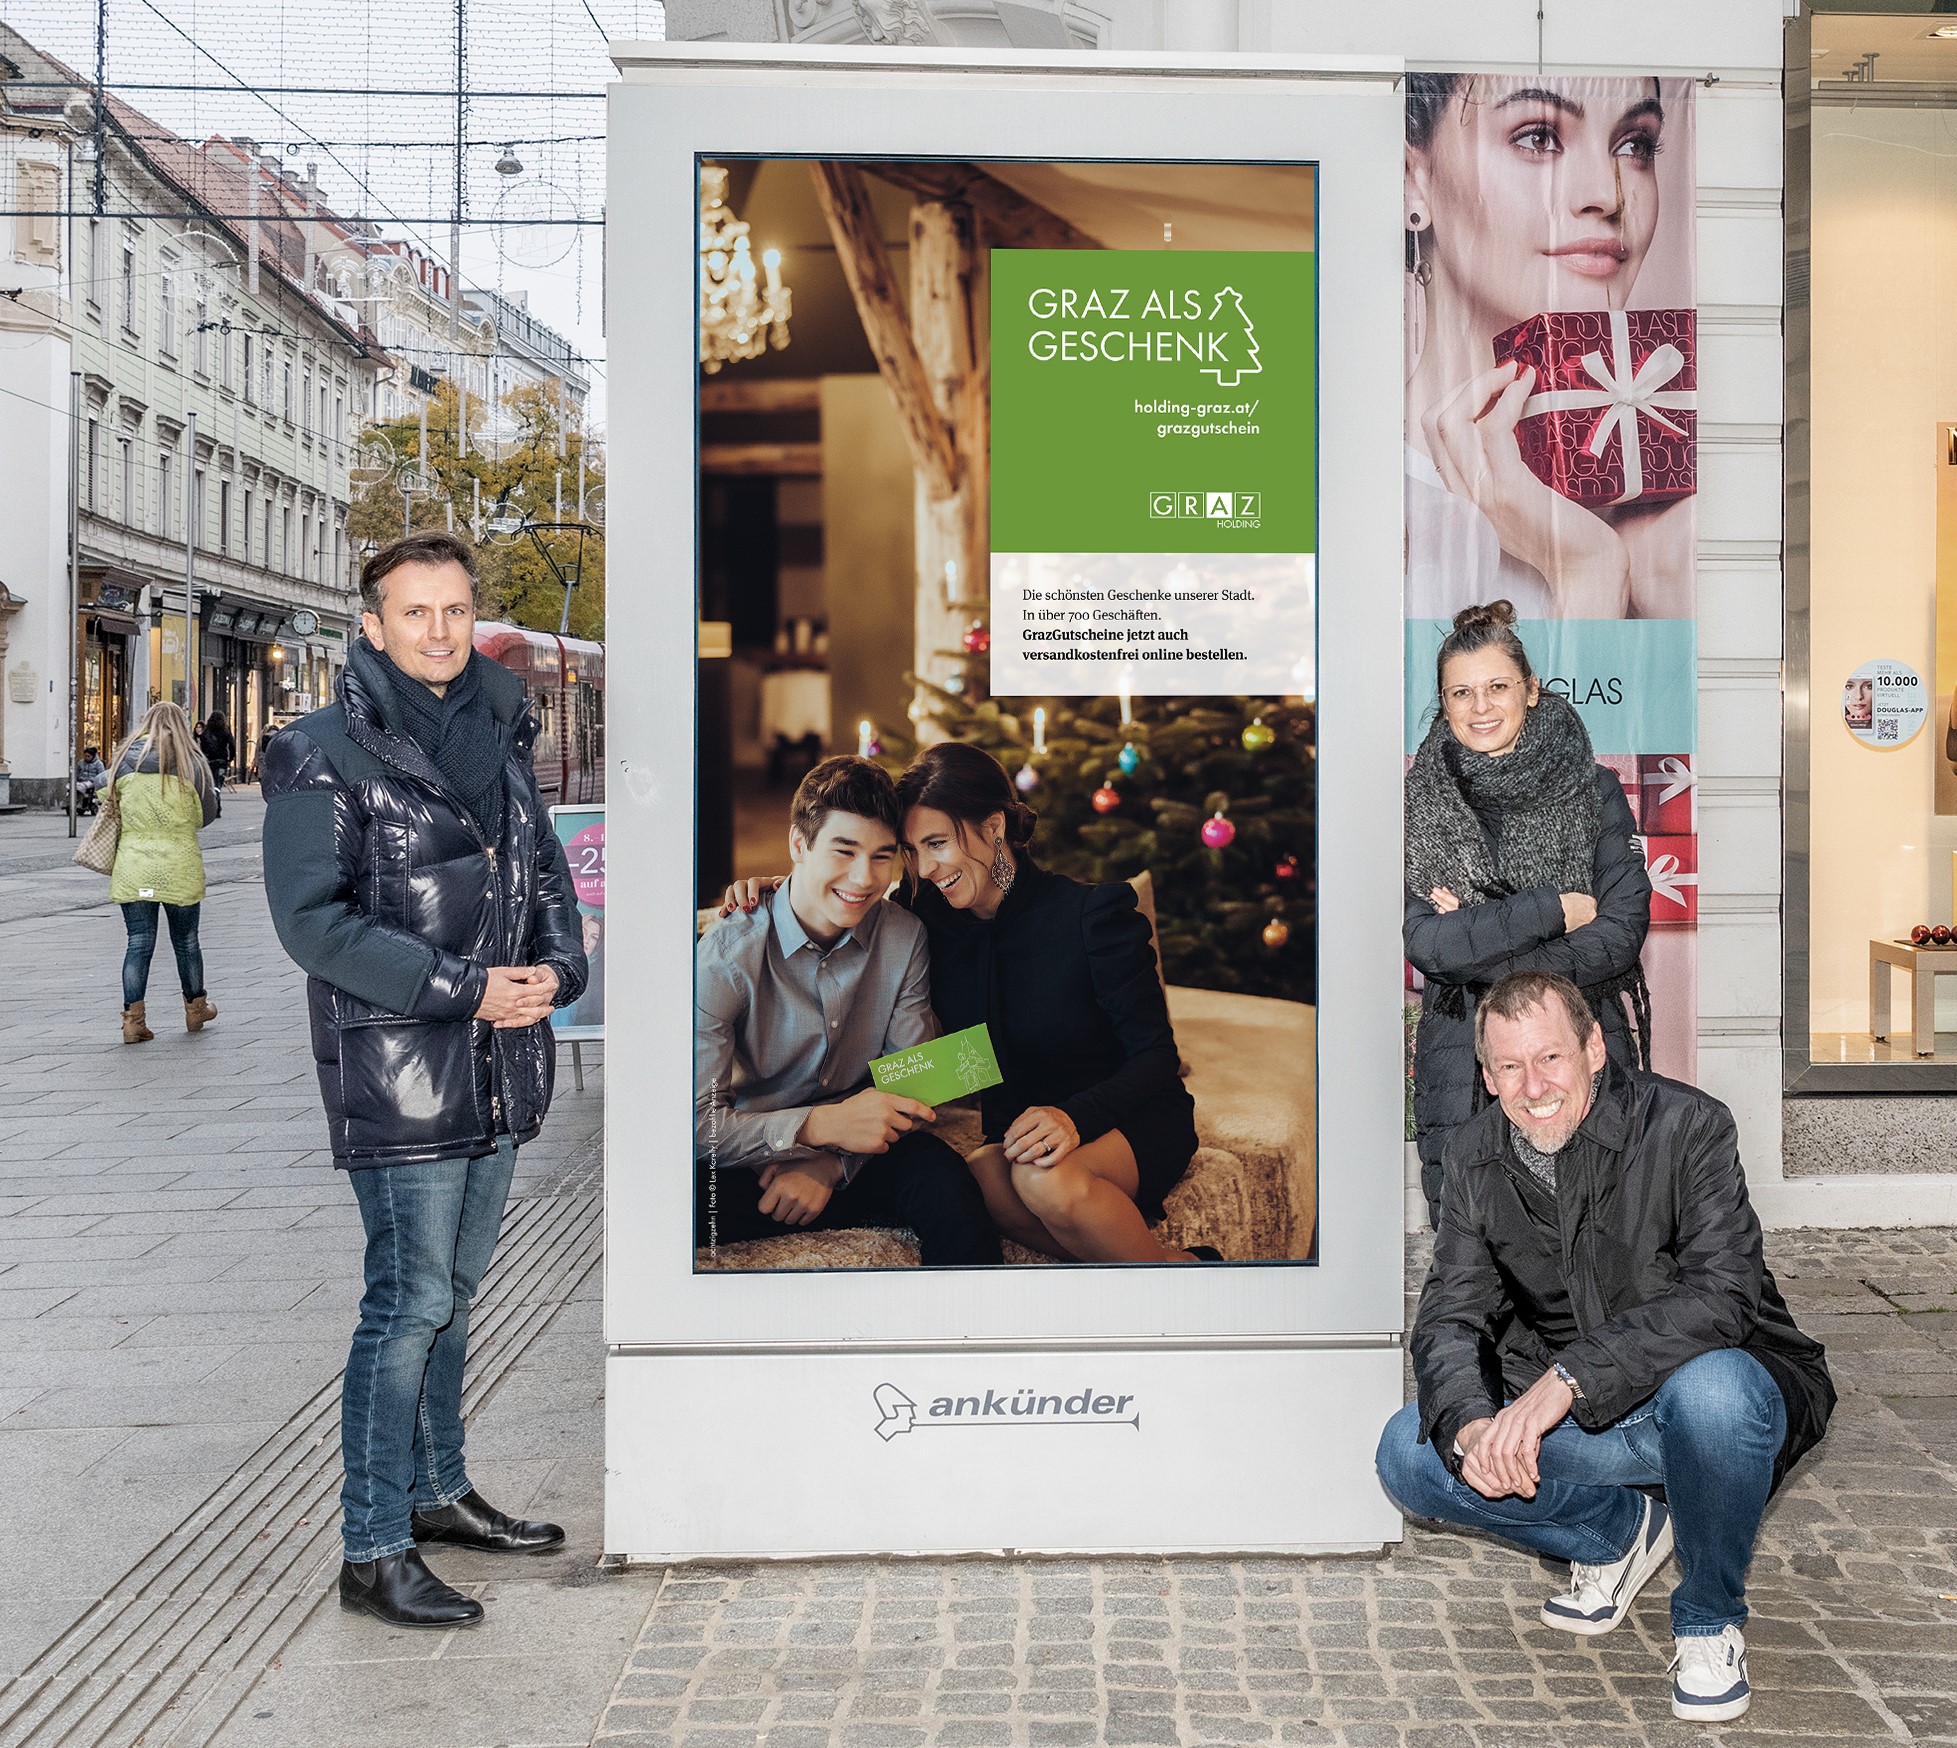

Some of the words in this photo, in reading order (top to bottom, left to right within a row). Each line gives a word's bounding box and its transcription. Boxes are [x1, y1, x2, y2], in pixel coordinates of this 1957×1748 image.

[1028, 288, 1130, 319] GRAZ
[1140, 289, 1202, 320] ALS
[1028, 330, 1230, 362] GESCHENK
[1134, 399, 1260, 418] holding-graz.at/
[1156, 421, 1260, 438] grazgutschein
[1151, 493, 1260, 517] GRAZ
[1216, 519, 1261, 529] HOLDING
[1022, 589, 1043, 601] Die
[1045, 589, 1105, 601] schönsten
[1107, 589, 1172, 601] Geschenke
[1174, 591, 1219, 601] unserer
[1221, 589, 1255, 601] Stadt.
[1022, 610, 1035, 621] In
[1038, 609, 1066, 621] über
[1068, 611, 1090, 623] 700
[1092, 609, 1162, 621] Geschäften.
[1022, 629, 1124, 641] GrazGutscheine
[1126, 629, 1155, 643] jetzt
[1157, 629, 1189, 641] auch
[1022, 649, 1139, 661] versandkostenfrei
[1141, 649, 1184, 661] online
[1186, 649, 1248, 661] bestellen.
[1877, 676, 1918, 687] 10.000
[580, 878, 600, 889] auf
[877, 1058, 906, 1075] GRAZ
[907, 1051, 924, 1064] ALS
[881, 1059, 935, 1085] GESCHENK
[928, 1388, 1134, 1417] ankünder
